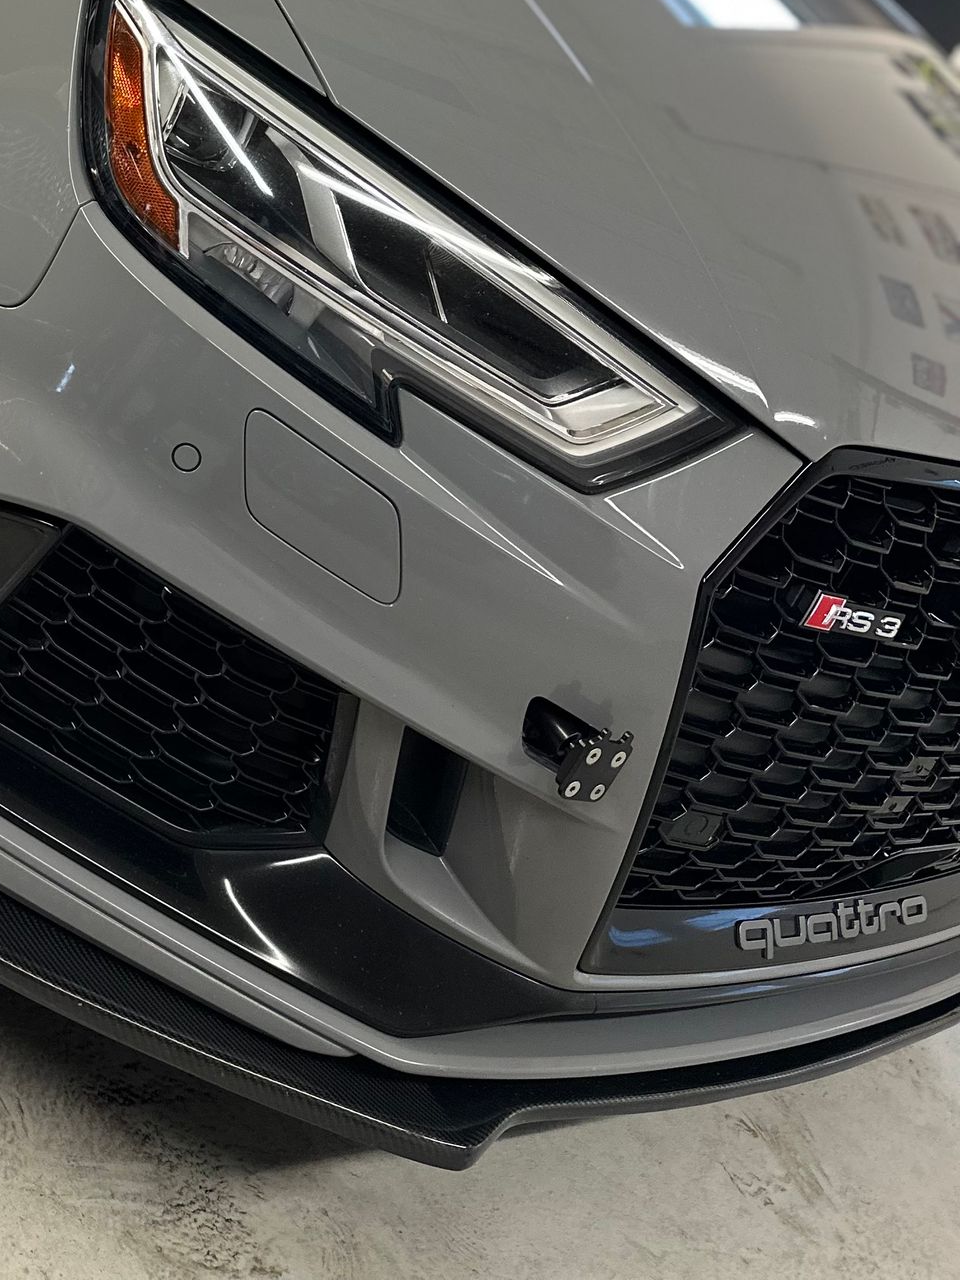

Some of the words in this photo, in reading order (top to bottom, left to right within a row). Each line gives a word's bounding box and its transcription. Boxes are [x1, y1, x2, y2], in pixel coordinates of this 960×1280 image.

[821, 604, 875, 633] RS
[875, 616, 902, 638] 3
[734, 894, 928, 960] quattro
